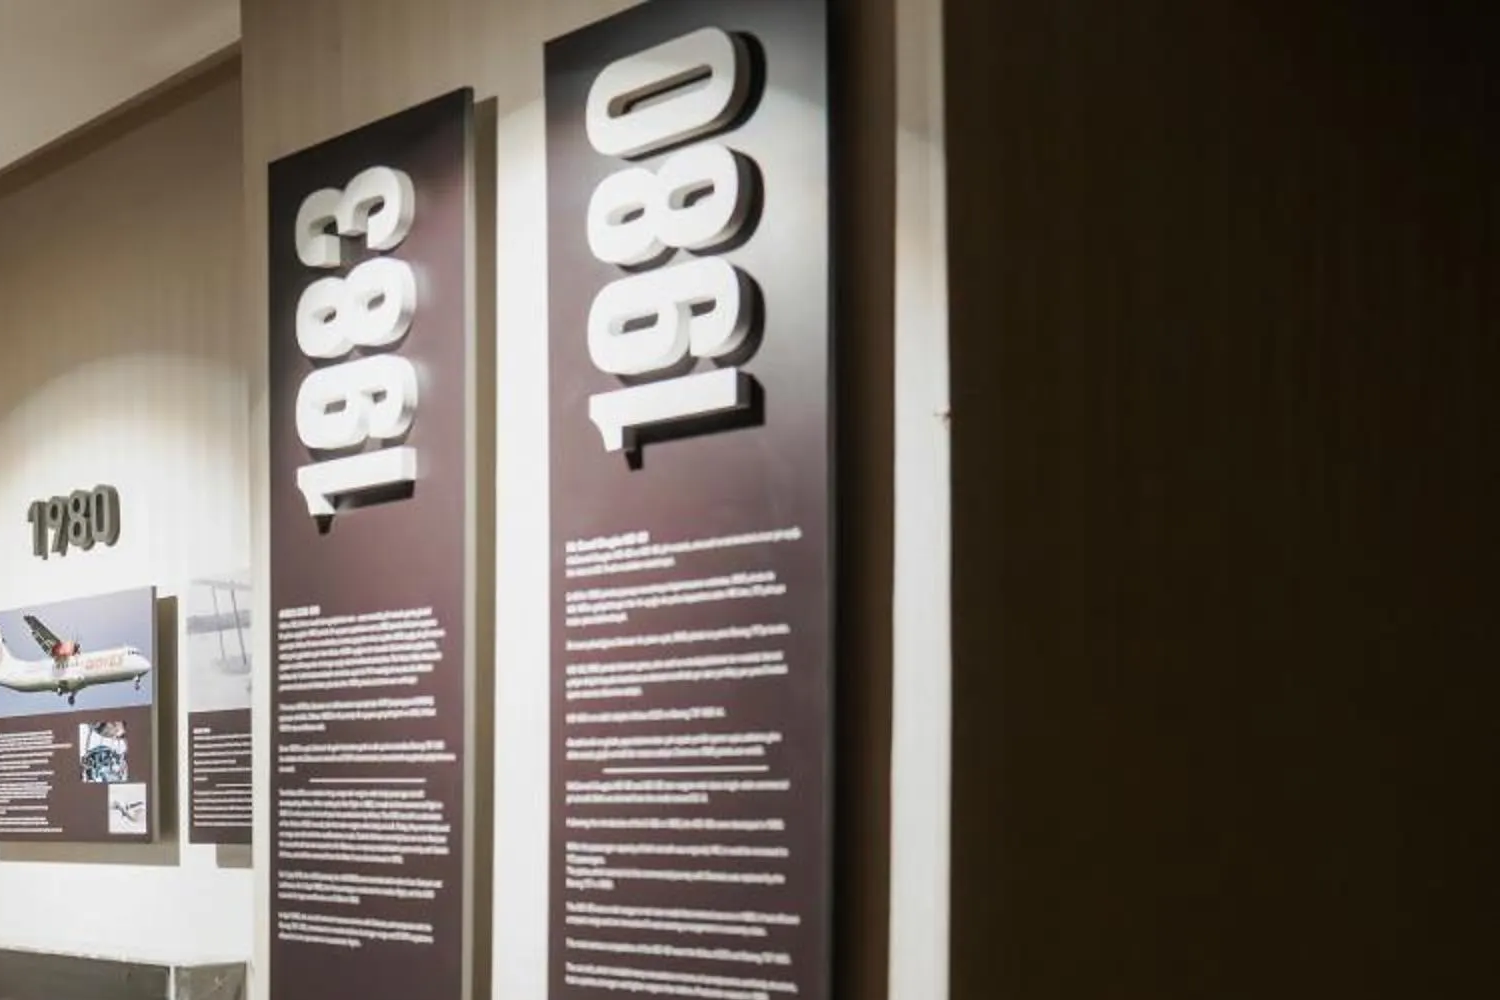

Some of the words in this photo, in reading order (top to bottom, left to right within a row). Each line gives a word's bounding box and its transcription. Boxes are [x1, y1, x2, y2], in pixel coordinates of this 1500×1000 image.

[295, 166, 418, 516] 1983
[586, 27, 752, 456] 1980
[27, 484, 120, 559] 1980
